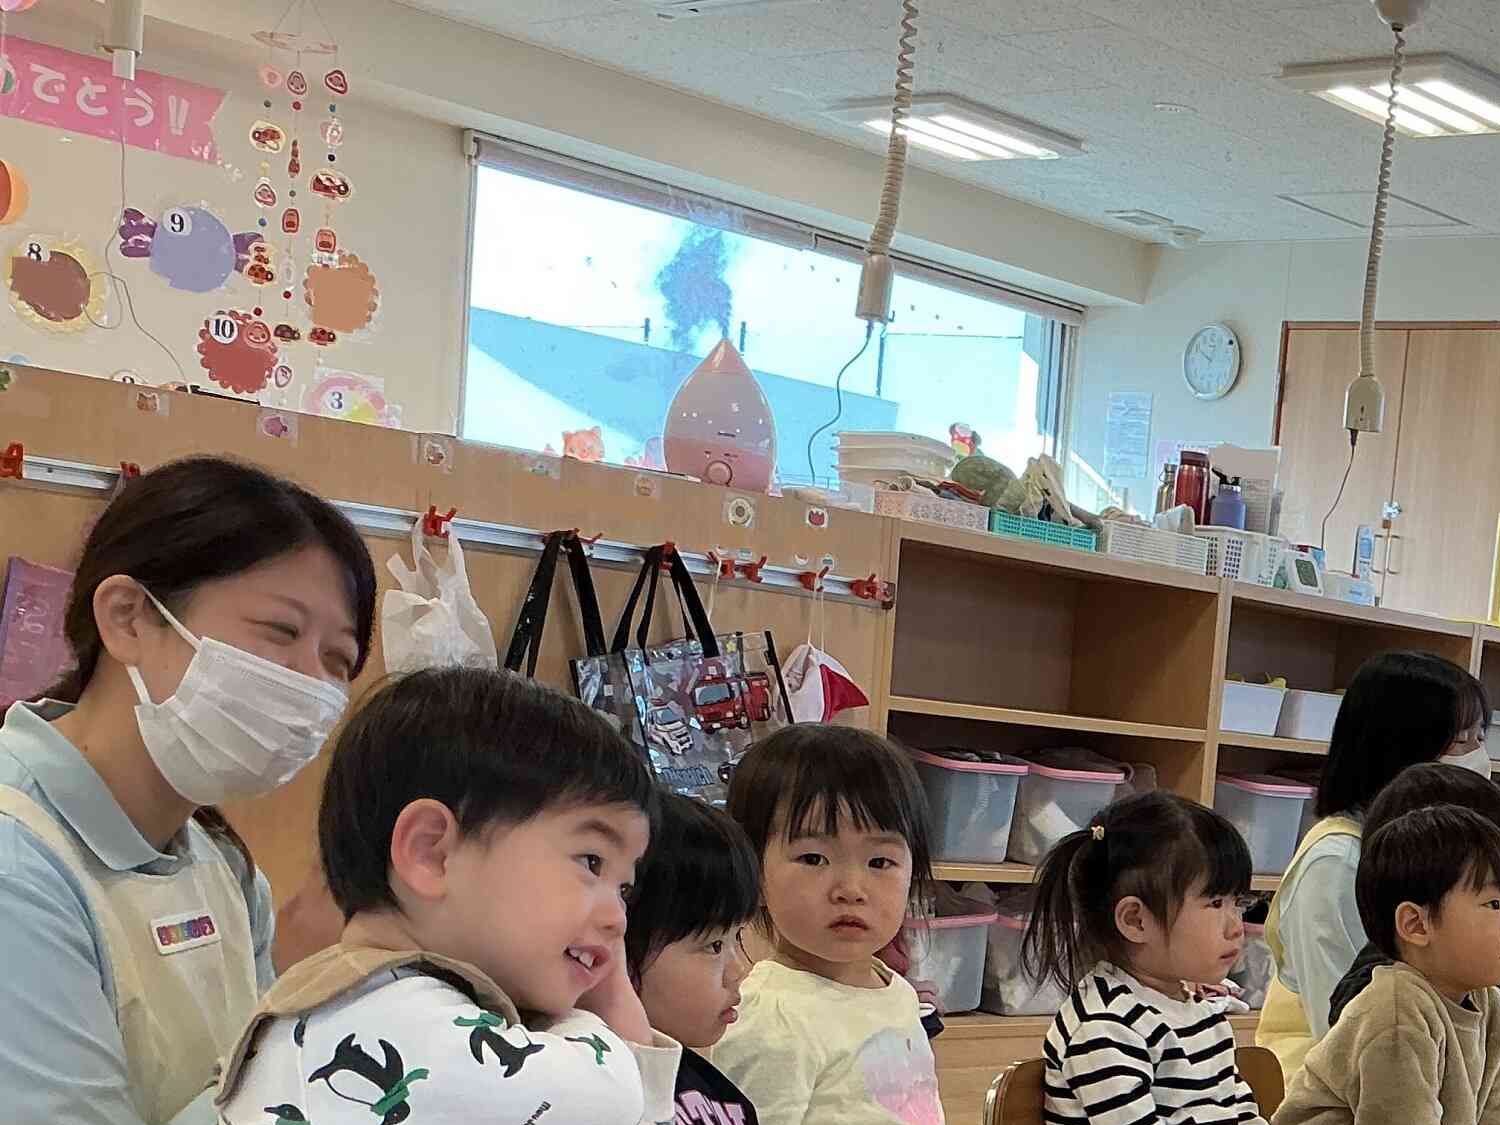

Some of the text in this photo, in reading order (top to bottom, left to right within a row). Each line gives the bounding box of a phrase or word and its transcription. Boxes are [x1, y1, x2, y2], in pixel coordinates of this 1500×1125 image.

[171, 213, 184, 232] 9
[214, 319, 234, 337] 10
[330, 391, 343, 410] 3
